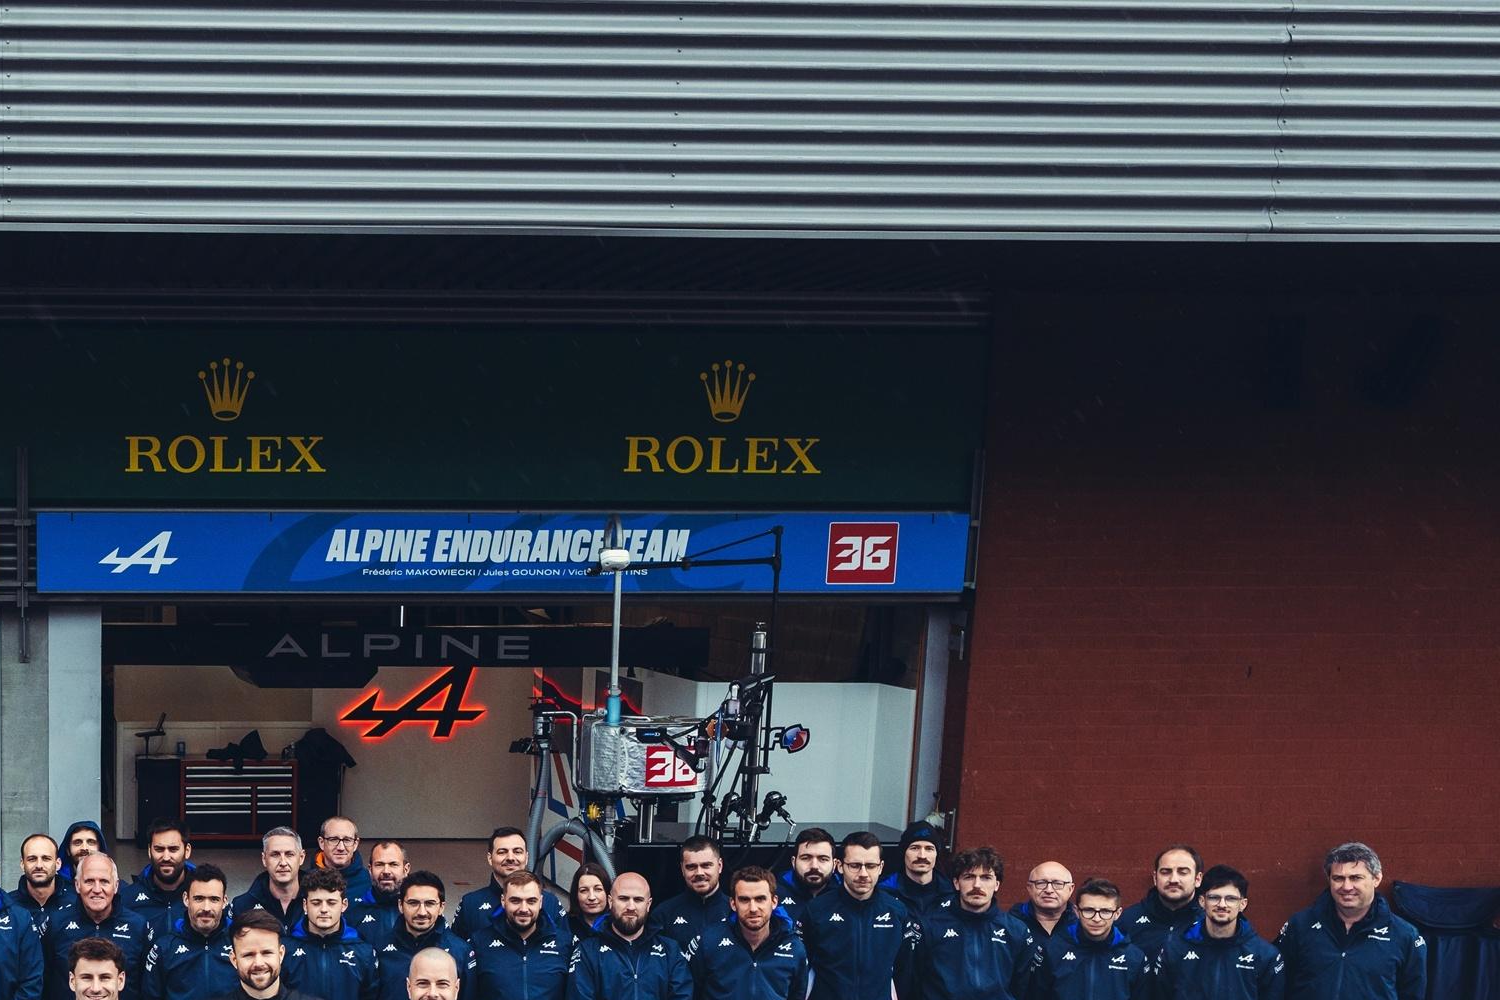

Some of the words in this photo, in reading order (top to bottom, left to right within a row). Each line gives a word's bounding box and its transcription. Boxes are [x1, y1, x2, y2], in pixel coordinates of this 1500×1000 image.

[124, 436, 327, 473] ROLEX
[624, 437, 823, 474] ROLEX
[325, 529, 431, 562] ALPINE
[432, 529, 606, 562] ENDURANCE
[833, 536, 892, 571] 36
[362, 567, 402, 576] Frédéric
[405, 568, 476, 576] MAKOWIECKI
[483, 567, 510, 576] Jules
[512, 568, 560, 576] GOUNON
[265, 633, 530, 660] ALPINE
